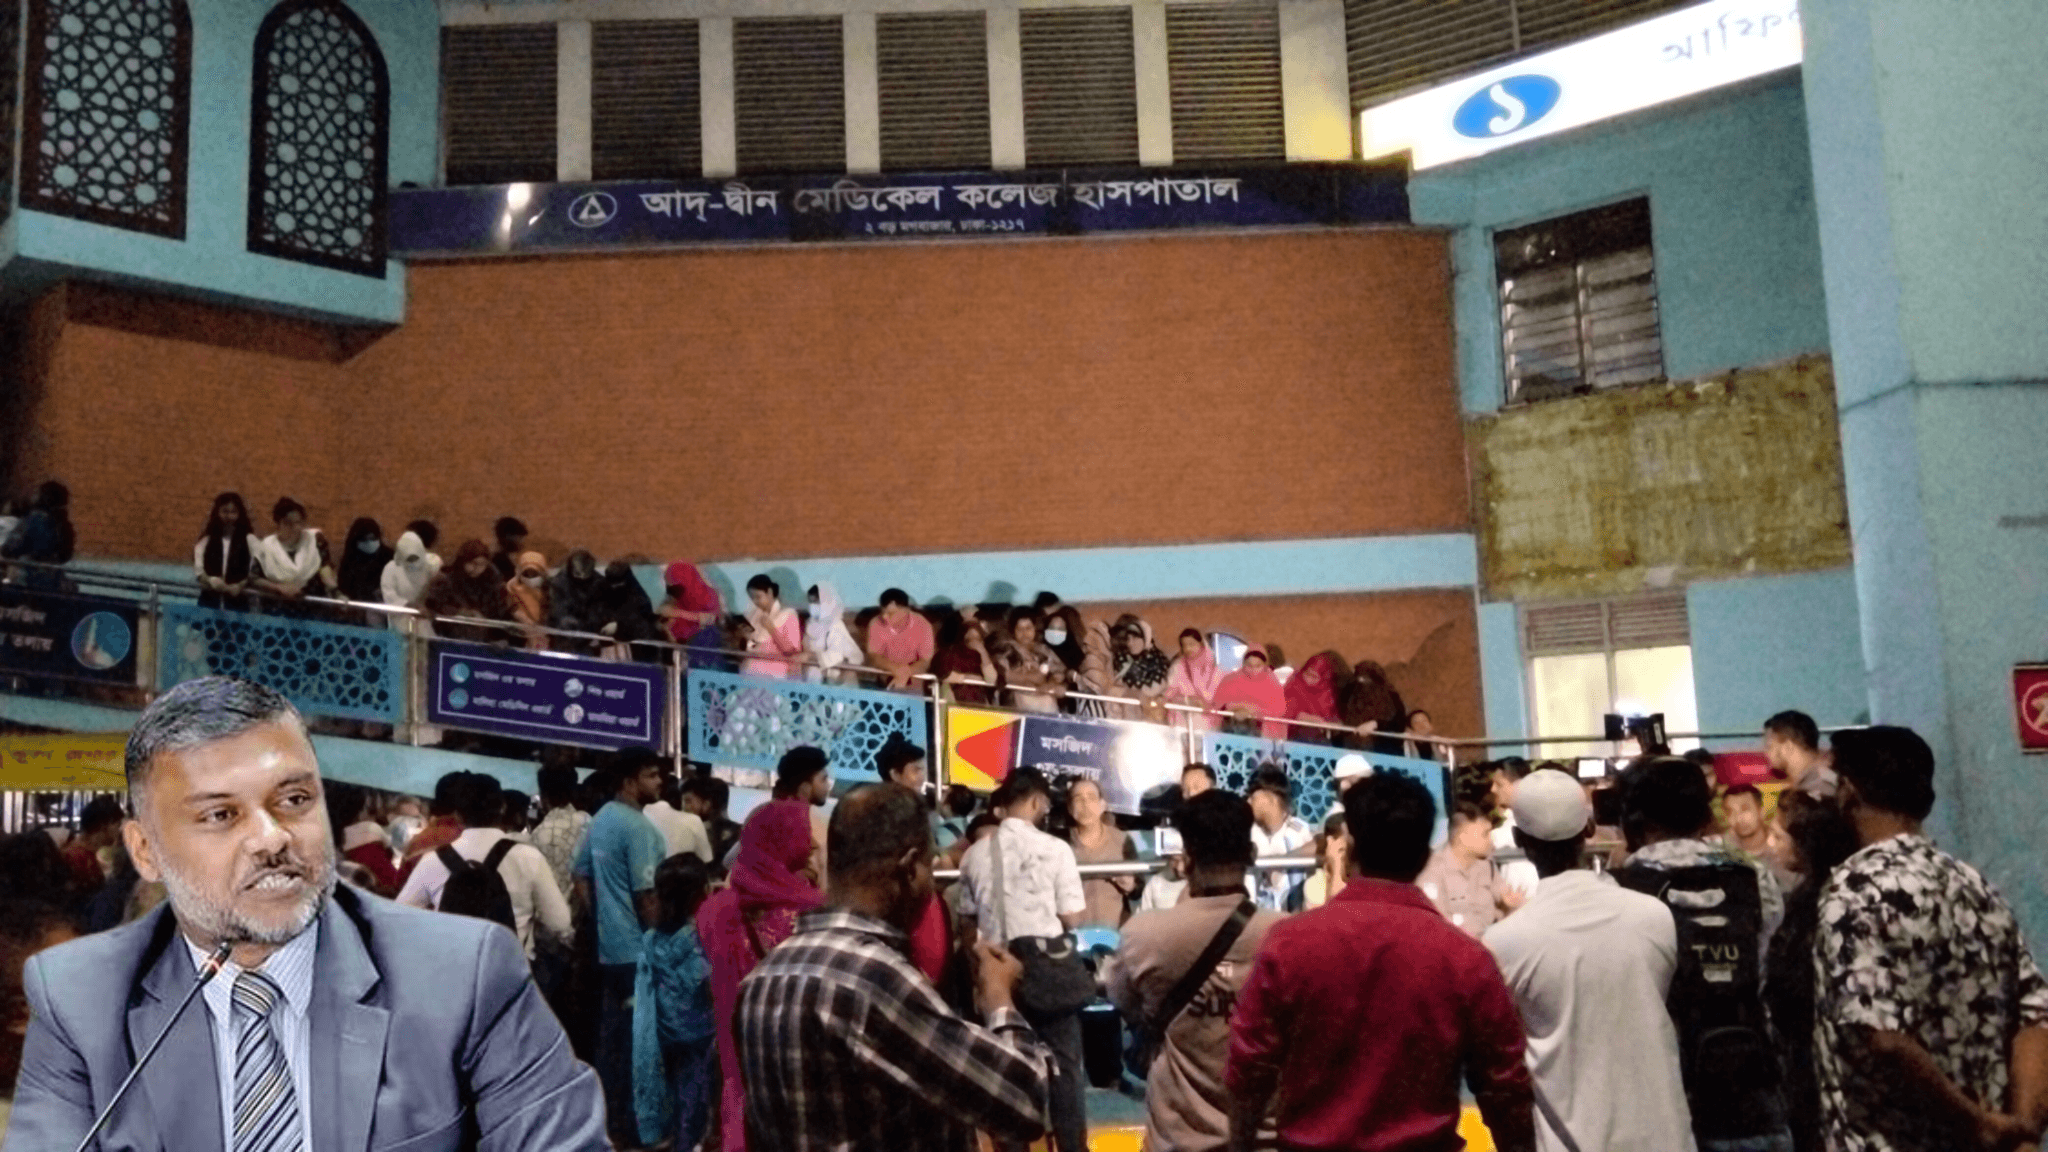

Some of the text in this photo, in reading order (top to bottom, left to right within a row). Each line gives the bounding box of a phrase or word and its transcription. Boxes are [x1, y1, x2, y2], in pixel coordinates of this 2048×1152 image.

[793, 179, 945, 212] মেডিকেল
[952, 182, 1061, 209] কলেজ
[1070, 177, 1243, 210] হাসপাতাল
[1040, 734, 1094, 756] মসজিদ
[1691, 944, 1740, 961] TVU
